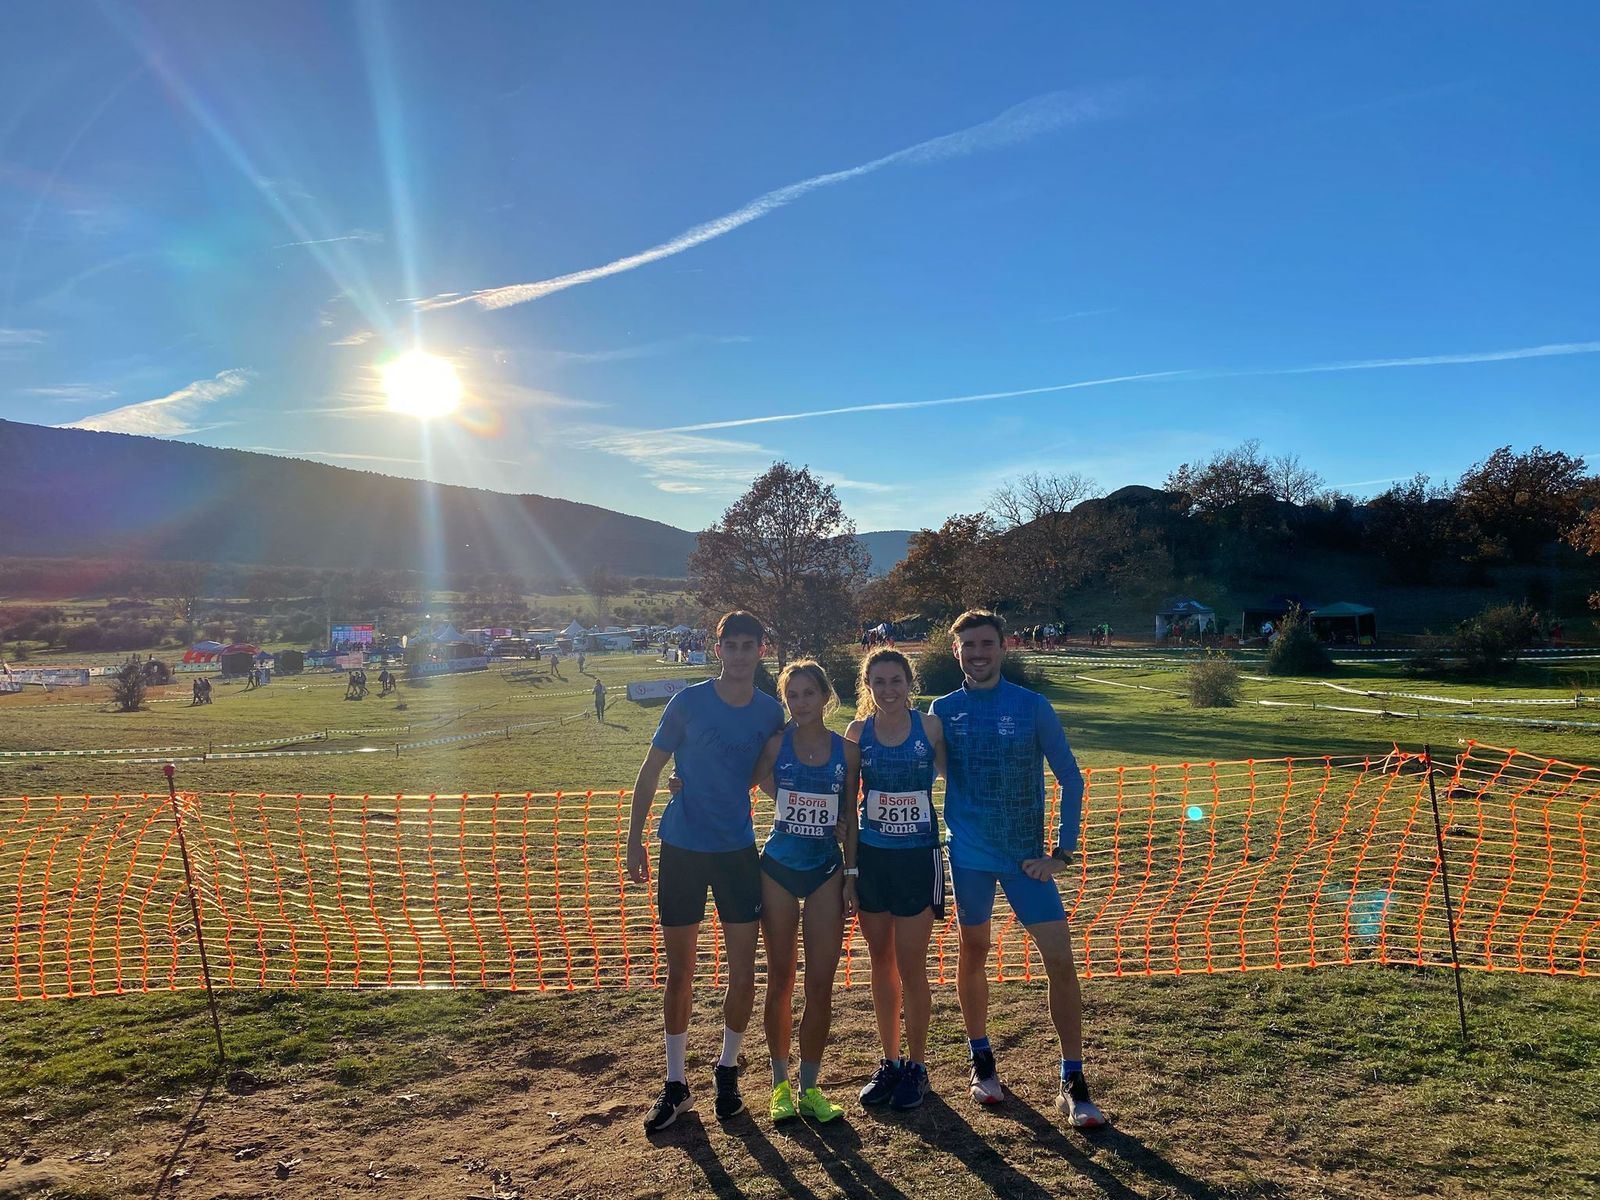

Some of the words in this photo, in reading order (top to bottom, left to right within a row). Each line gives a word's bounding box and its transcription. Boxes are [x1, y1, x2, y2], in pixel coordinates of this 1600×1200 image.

[798, 796, 827, 807] Soria
[888, 796, 917, 806] Soria
[785, 806, 829, 825] 2618
[877, 806, 920, 822] 2618
[786, 824, 825, 836] Joma
[879, 822, 918, 834] Joma
